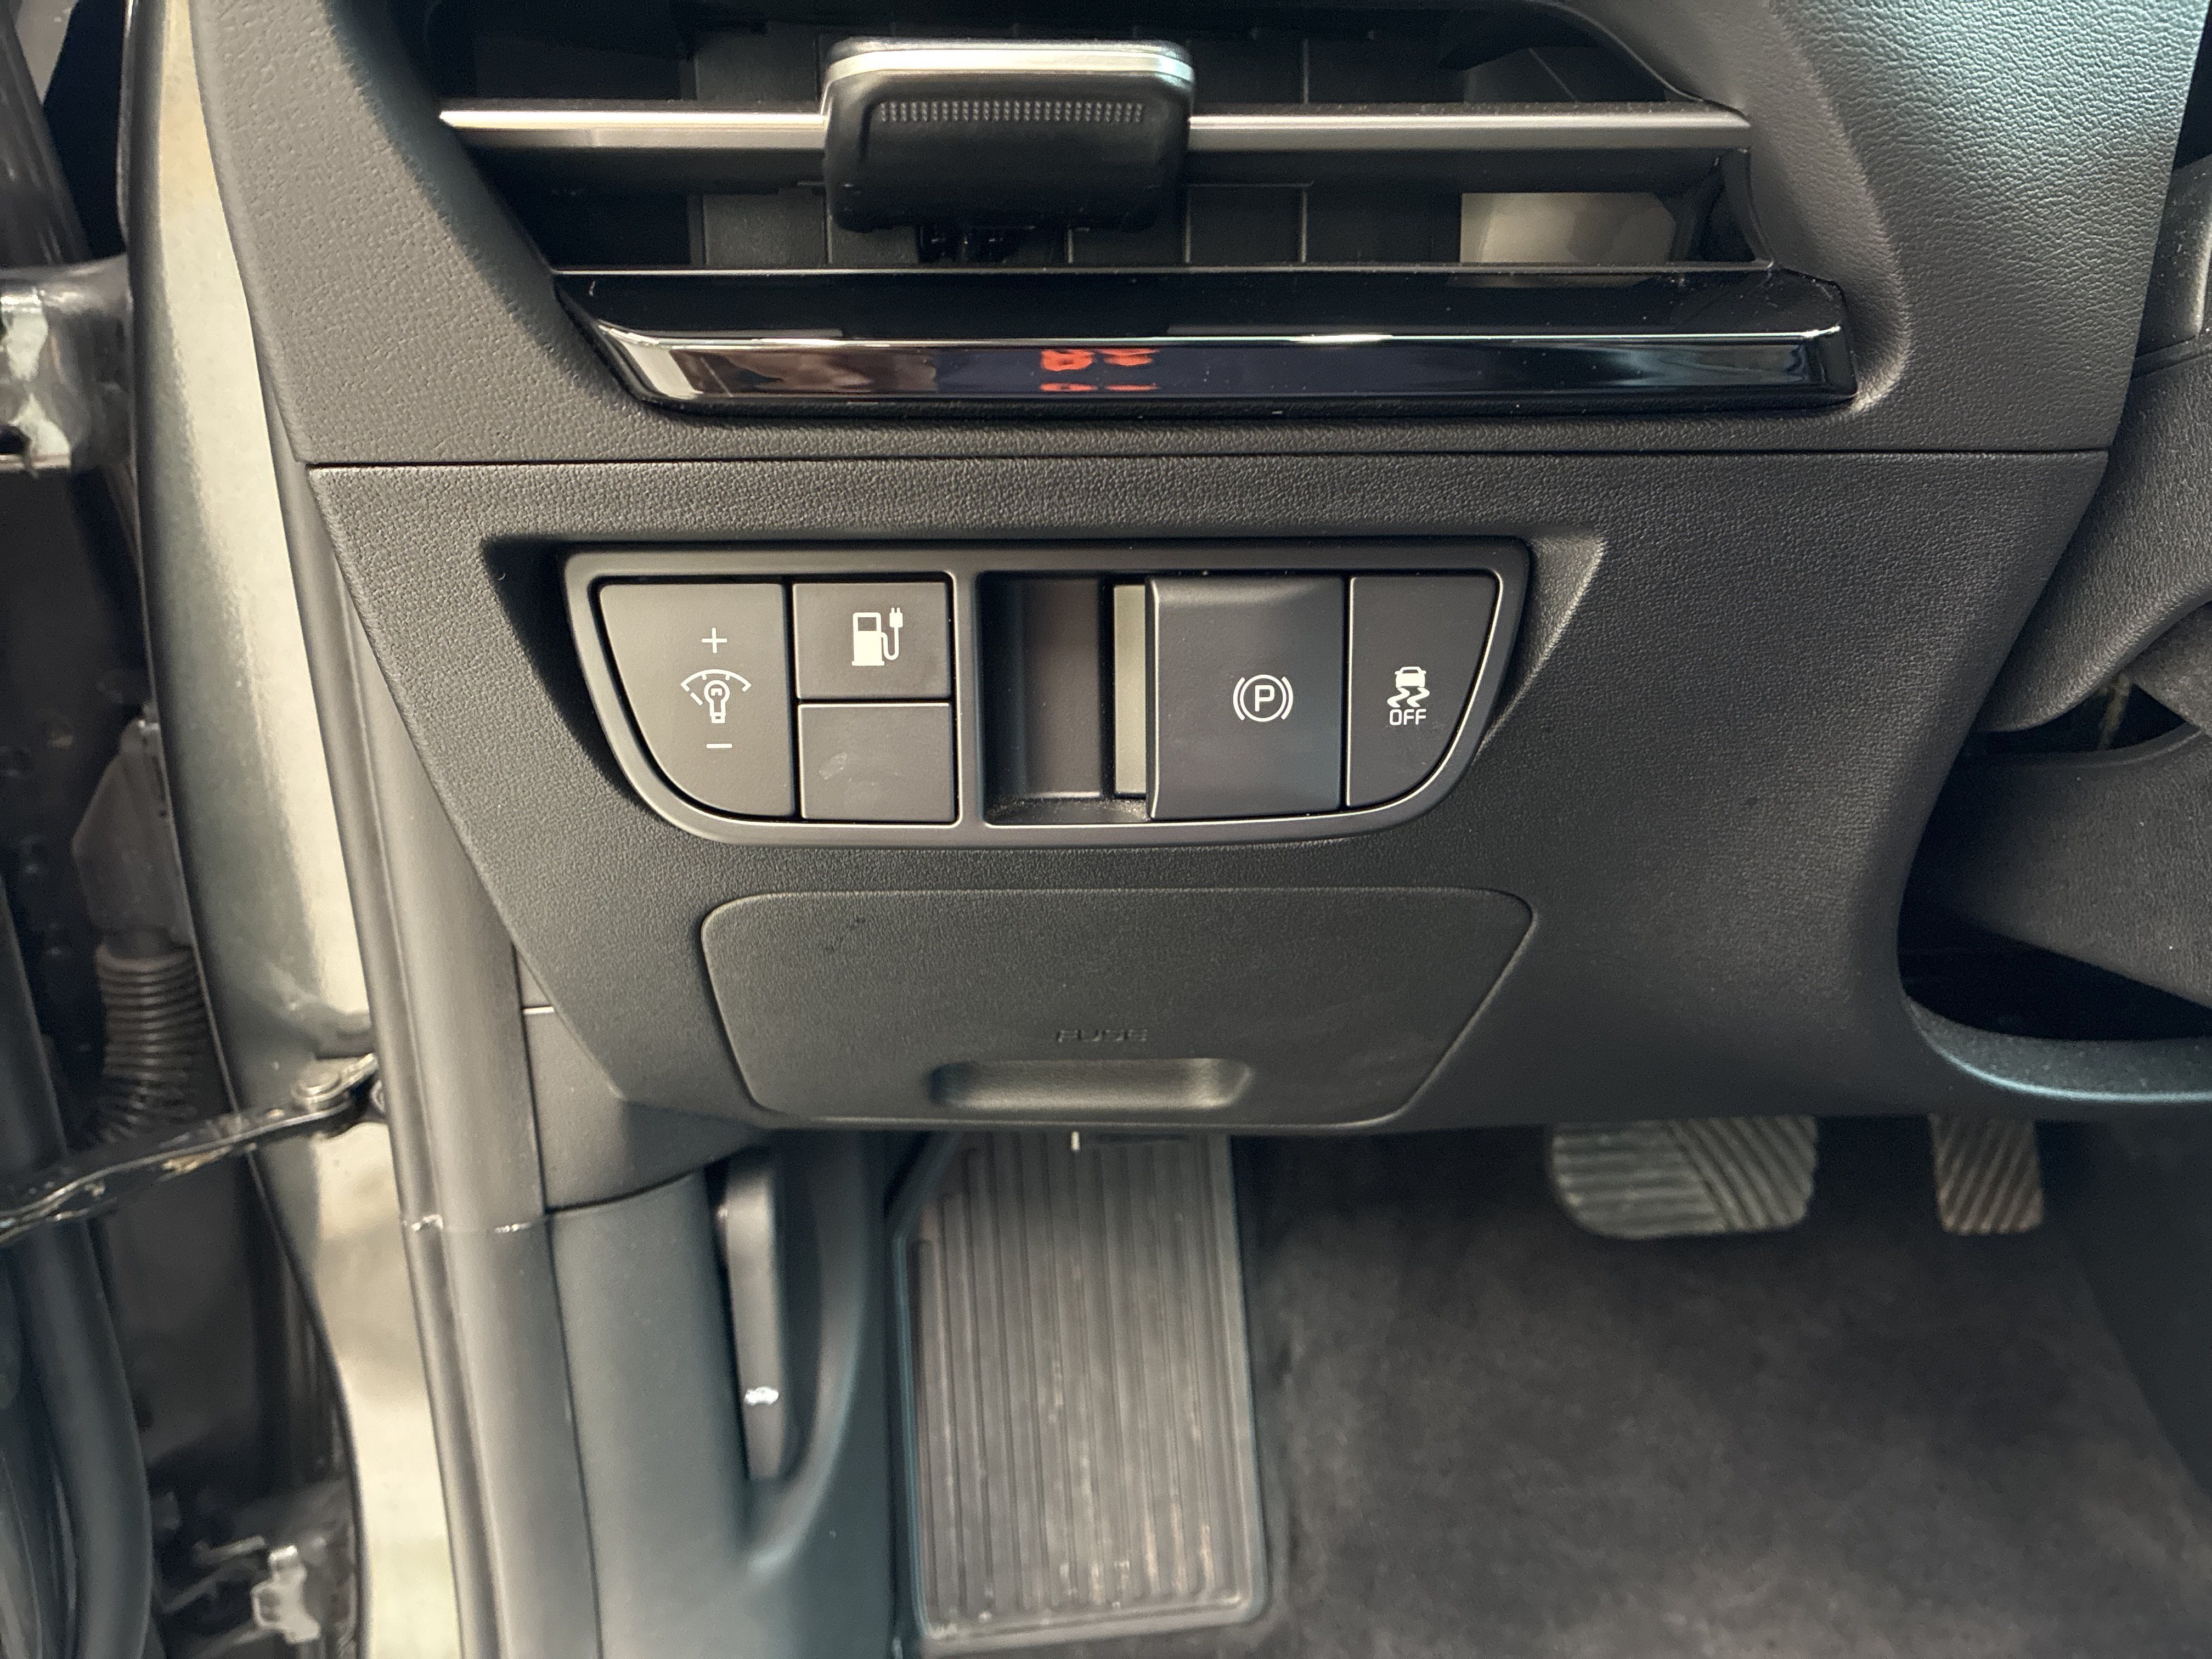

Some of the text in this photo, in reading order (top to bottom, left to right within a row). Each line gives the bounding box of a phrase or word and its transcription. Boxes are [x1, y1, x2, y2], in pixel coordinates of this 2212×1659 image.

[1255, 685, 1275, 712] P
[1389, 708, 1427, 725] OFF
[1056, 1028, 1148, 1043] FUSE
